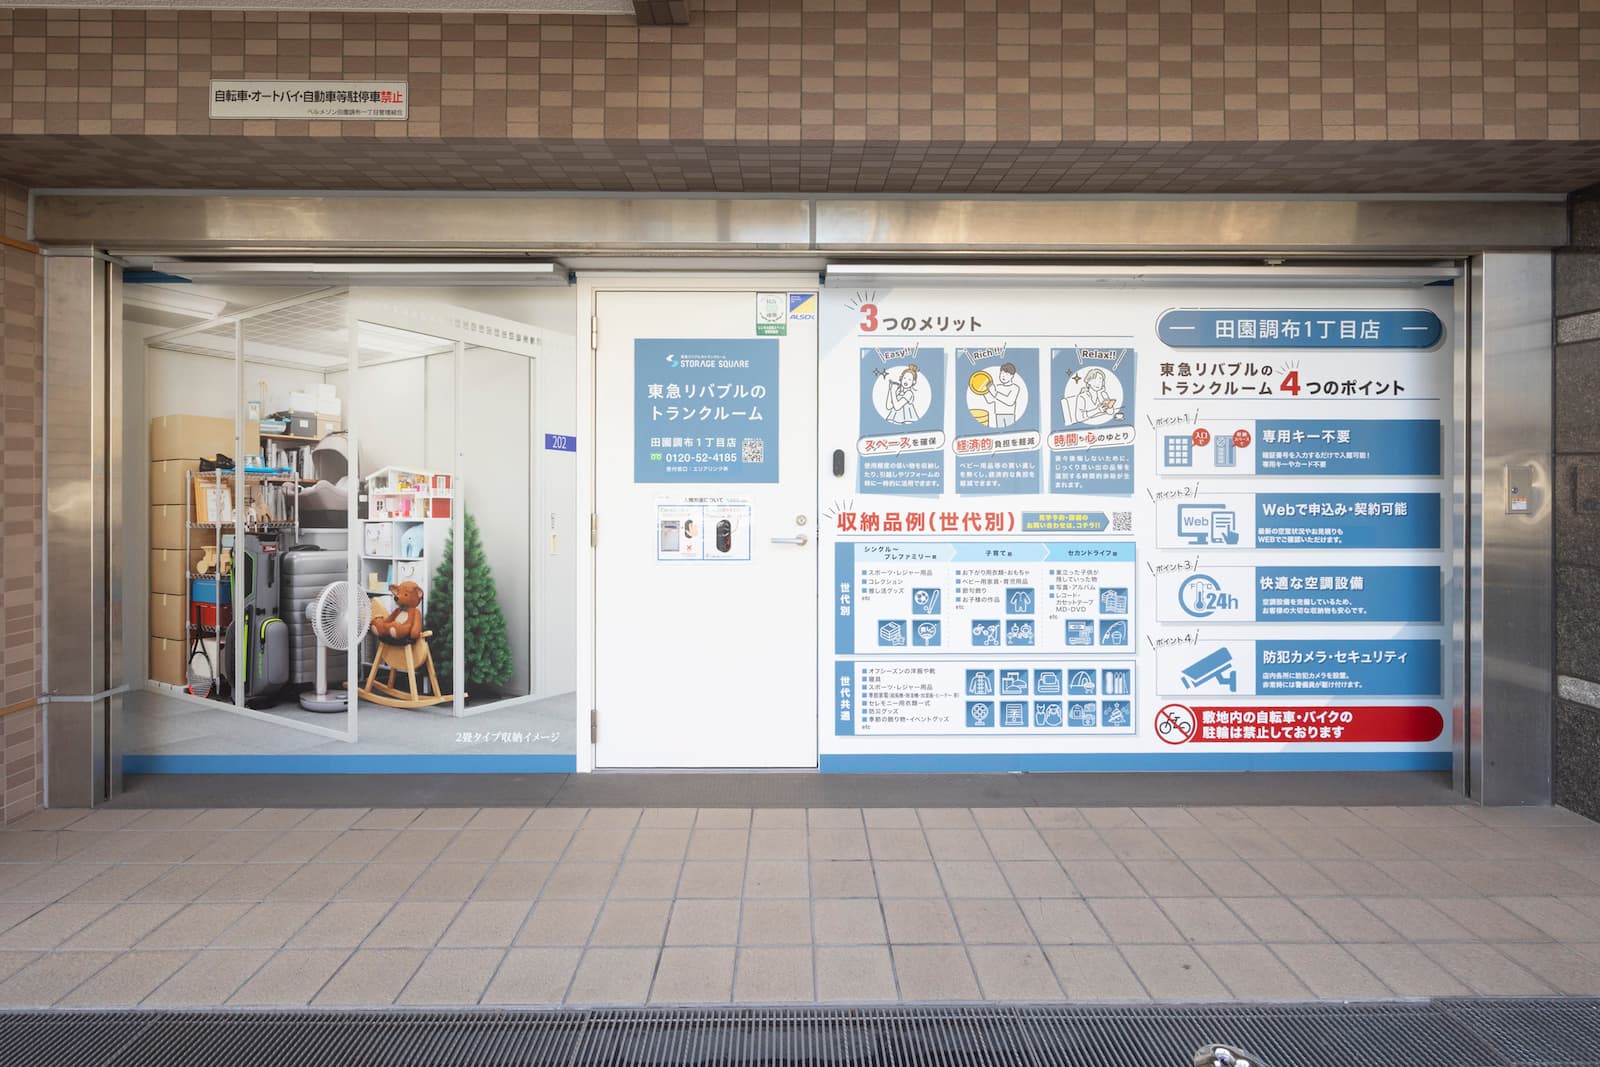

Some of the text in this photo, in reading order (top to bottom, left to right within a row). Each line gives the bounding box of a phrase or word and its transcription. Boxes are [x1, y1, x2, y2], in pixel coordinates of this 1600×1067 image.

[215, 90, 404, 104] 自転車・オートバイ・自動車等駐停車禁止
[1215, 319, 1381, 340] 田園調布1丁目店
[680, 360, 750, 368] STORAGE SQUARE
[1160, 362, 1274, 377] 東急リバブルの
[647, 383, 766, 400] 東急リバブルの
[652, 406, 764, 421] トランクルーム
[552, 435, 568, 450] 202
[864, 436, 936, 451] スペースを確保
[956, 436, 1036, 451] 経済的負担を軽減
[1262, 430, 1352, 444] 専用キー不要
[666, 454, 737, 463] 0120-52-4185
[1262, 502, 1408, 516] Webで申込み・契約可能
[836, 511, 1016, 532] 収納品例(世代別)
[1184, 516, 1209, 527] Web
[1260, 576, 1364, 591] 快適な空調設備
[1206, 592, 1239, 610] 24h
[1263, 650, 1408, 664] 防犯カメラ・セキュリティ
[1202, 710, 1353, 724] 敷地内の自転車・バイクの
[1202, 725, 1345, 739] 駐輪は禁止しております
